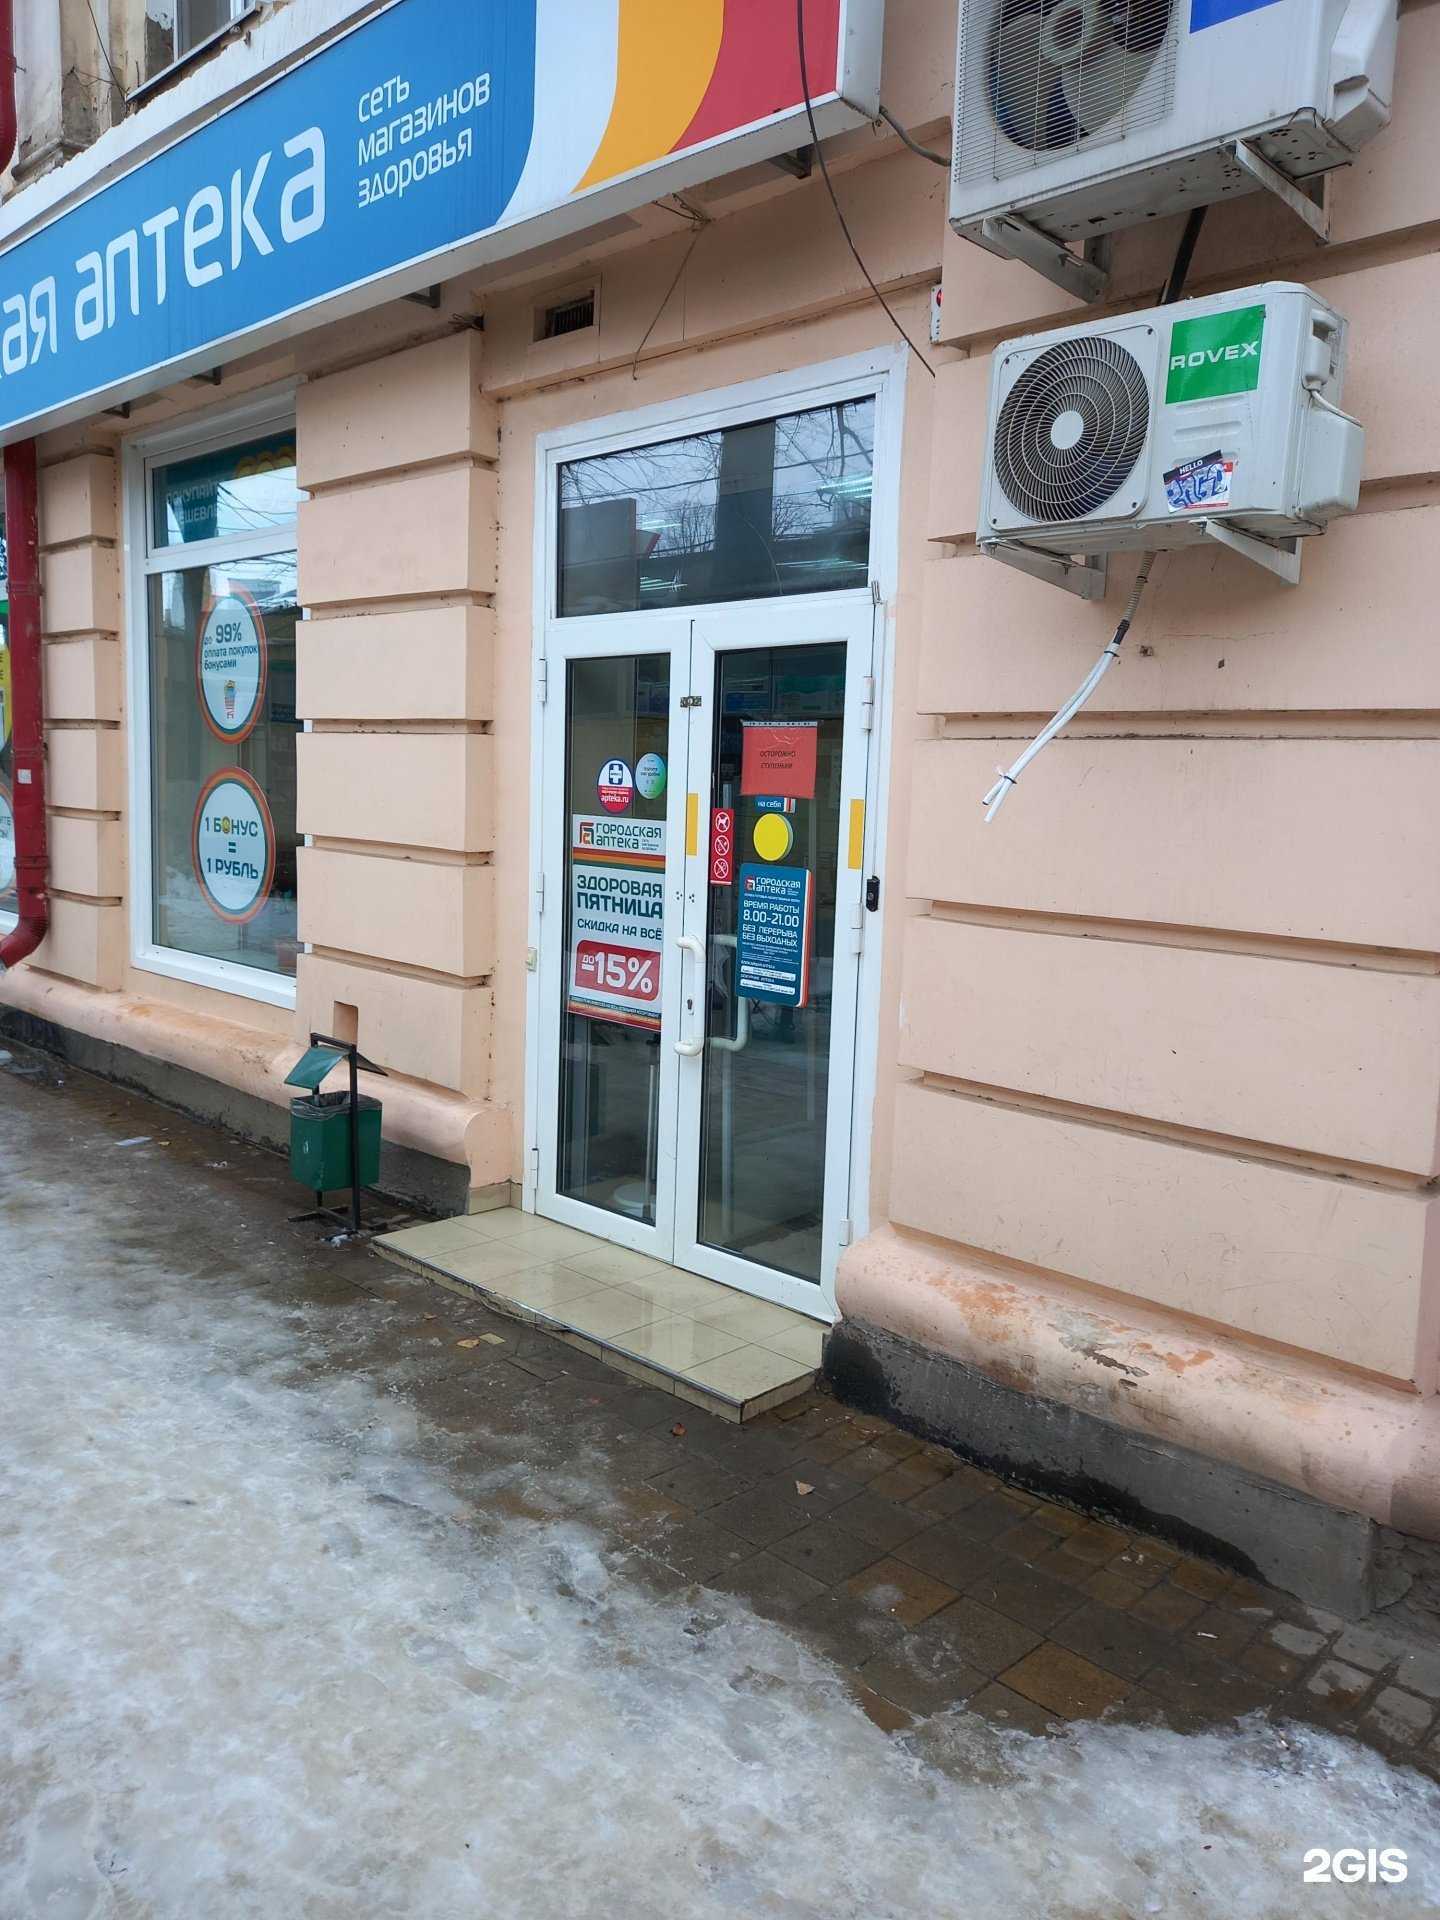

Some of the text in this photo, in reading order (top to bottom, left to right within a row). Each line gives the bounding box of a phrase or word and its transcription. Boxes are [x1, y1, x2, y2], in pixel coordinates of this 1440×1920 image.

[358, 74, 410, 123] сеть
[358, 72, 490, 167] магазинов
[358, 127, 472, 209] здоровья
[0, 275, 58, 378] ая
[1170, 340, 1260, 371] ROVEX
[1179, 459, 1203, 475] HELLO
[215, 622, 242, 643] 99%
[204, 645, 258, 659] оплата покупок
[204, 659, 237, 671] бонусами
[205, 816, 258, 837] 1 БОНУС
[207, 858, 259, 880] 1 РУБЛЬ
[577, 875, 662, 899] ЗДОРОВАЯ
[577, 891, 663, 920] ПЯТНИЦА
[743, 900, 800, 914] ВРЕМЯ РАБОТЫ
[743, 909, 800, 928] 8.00-21.00
[577, 918, 662, 941] СКИДКА НА ВСЁ
[742, 924, 798, 938] БЕЗ ПЕРЕРЫВА
[742, 932, 798, 947] БЕЗ ВЫХОДНЫХ
